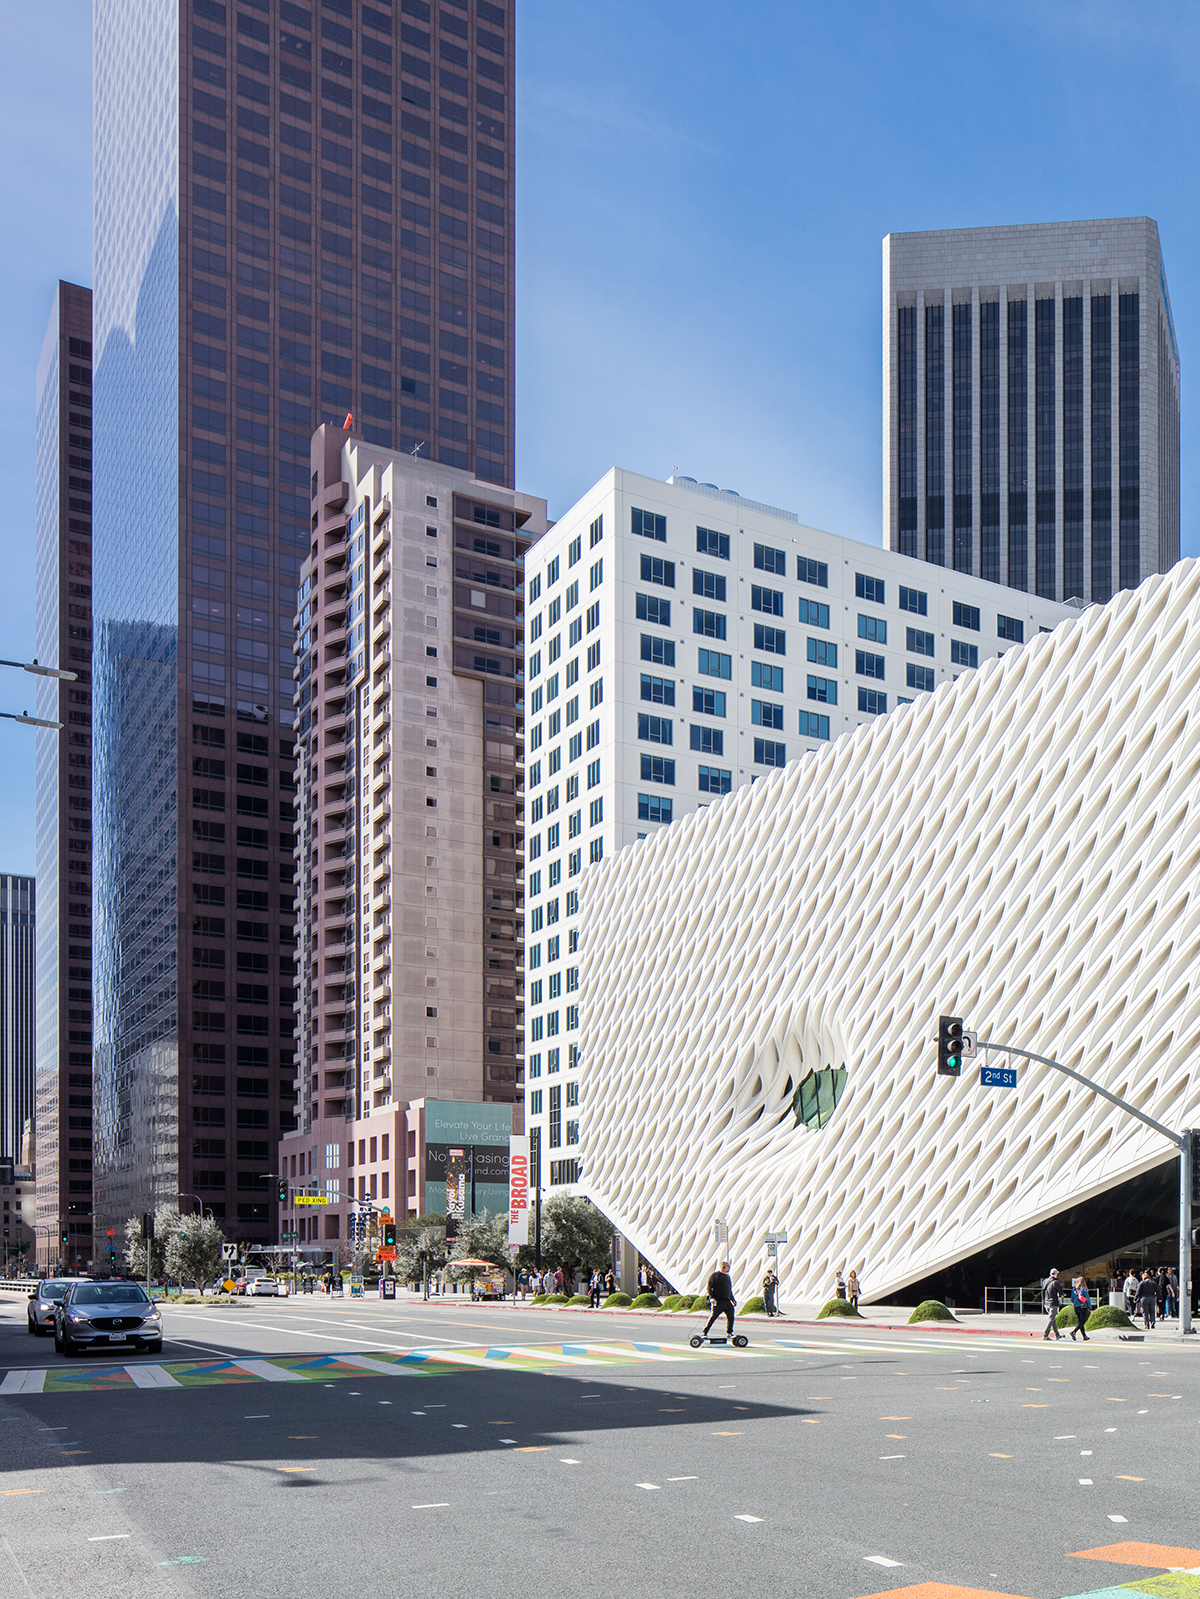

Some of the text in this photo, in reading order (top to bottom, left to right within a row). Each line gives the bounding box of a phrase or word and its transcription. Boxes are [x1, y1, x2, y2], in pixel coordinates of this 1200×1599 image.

[985, 1071, 1013, 1084] 2nd St
[434, 1119, 511, 1131] Elevate Your Life
[460, 1132, 478, 1140] Live
[428, 1150, 447, 1162] No
[511, 1155, 528, 1209] BROAD
[456, 1174, 465, 1213] Kusama
[446, 1189, 457, 1215] Yayoi
